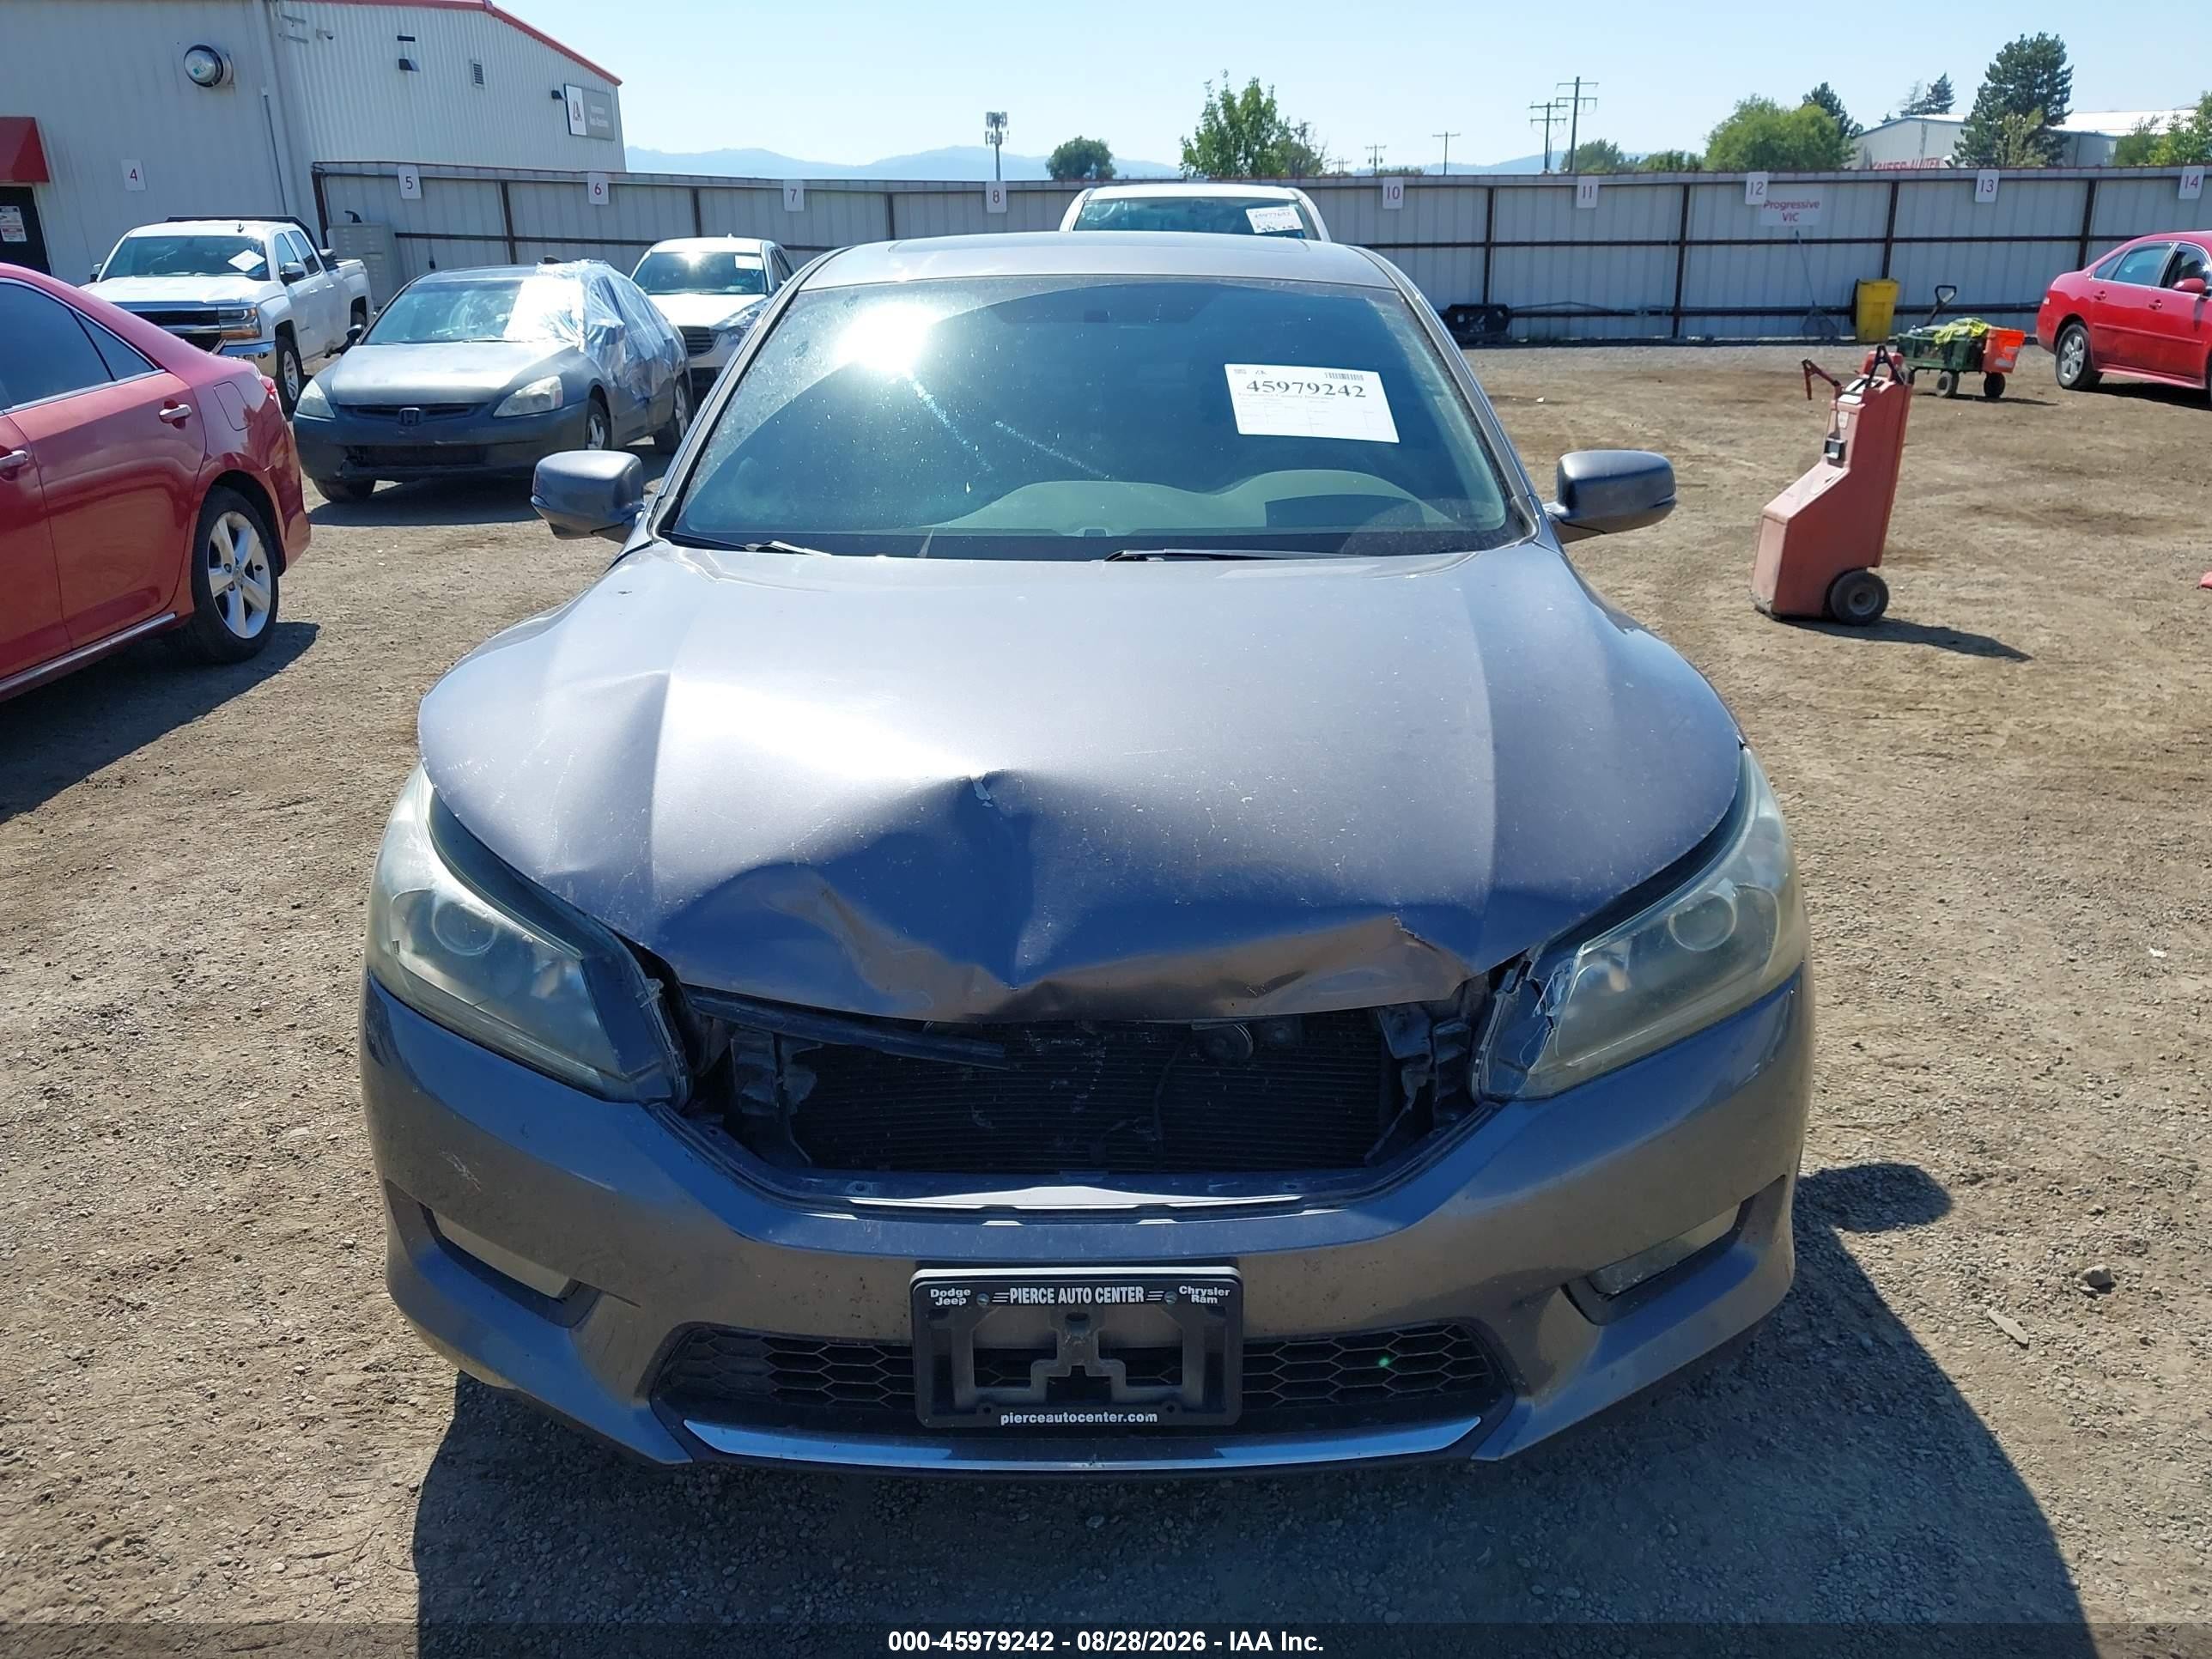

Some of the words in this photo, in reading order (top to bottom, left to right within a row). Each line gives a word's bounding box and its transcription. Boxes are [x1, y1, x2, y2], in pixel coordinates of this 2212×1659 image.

[130, 168, 138, 182] 4
[2185, 174, 2199, 190] 14
[405, 175, 413, 190] 5
[594, 182, 602, 196] 6
[1750, 181, 1764, 196] 12
[1980, 179, 1994, 193] 13
[790, 188, 798, 203] 7
[993, 190, 1000, 204] 8
[1387, 185, 1401, 199] 10
[1583, 185, 1593, 199] 11
[1763, 200, 1820, 211] Progressive
[1782, 212, 1800, 222] VIC
[1246, 380, 1366, 398] 45979242
[930, 1288, 971, 1298] Dodge
[1010, 1287, 1055, 1304] PIERCE
[1057, 1287, 1092, 1304] AUTO
[1095, 1286, 1145, 1304] CENTER
[1179, 1285, 1231, 1297] Chrysler
[935, 1297, 967, 1306] Jeep
[1191, 1295, 1218, 1304] Ram
[1000, 1412, 1158, 1425] pierceautocenter.com
